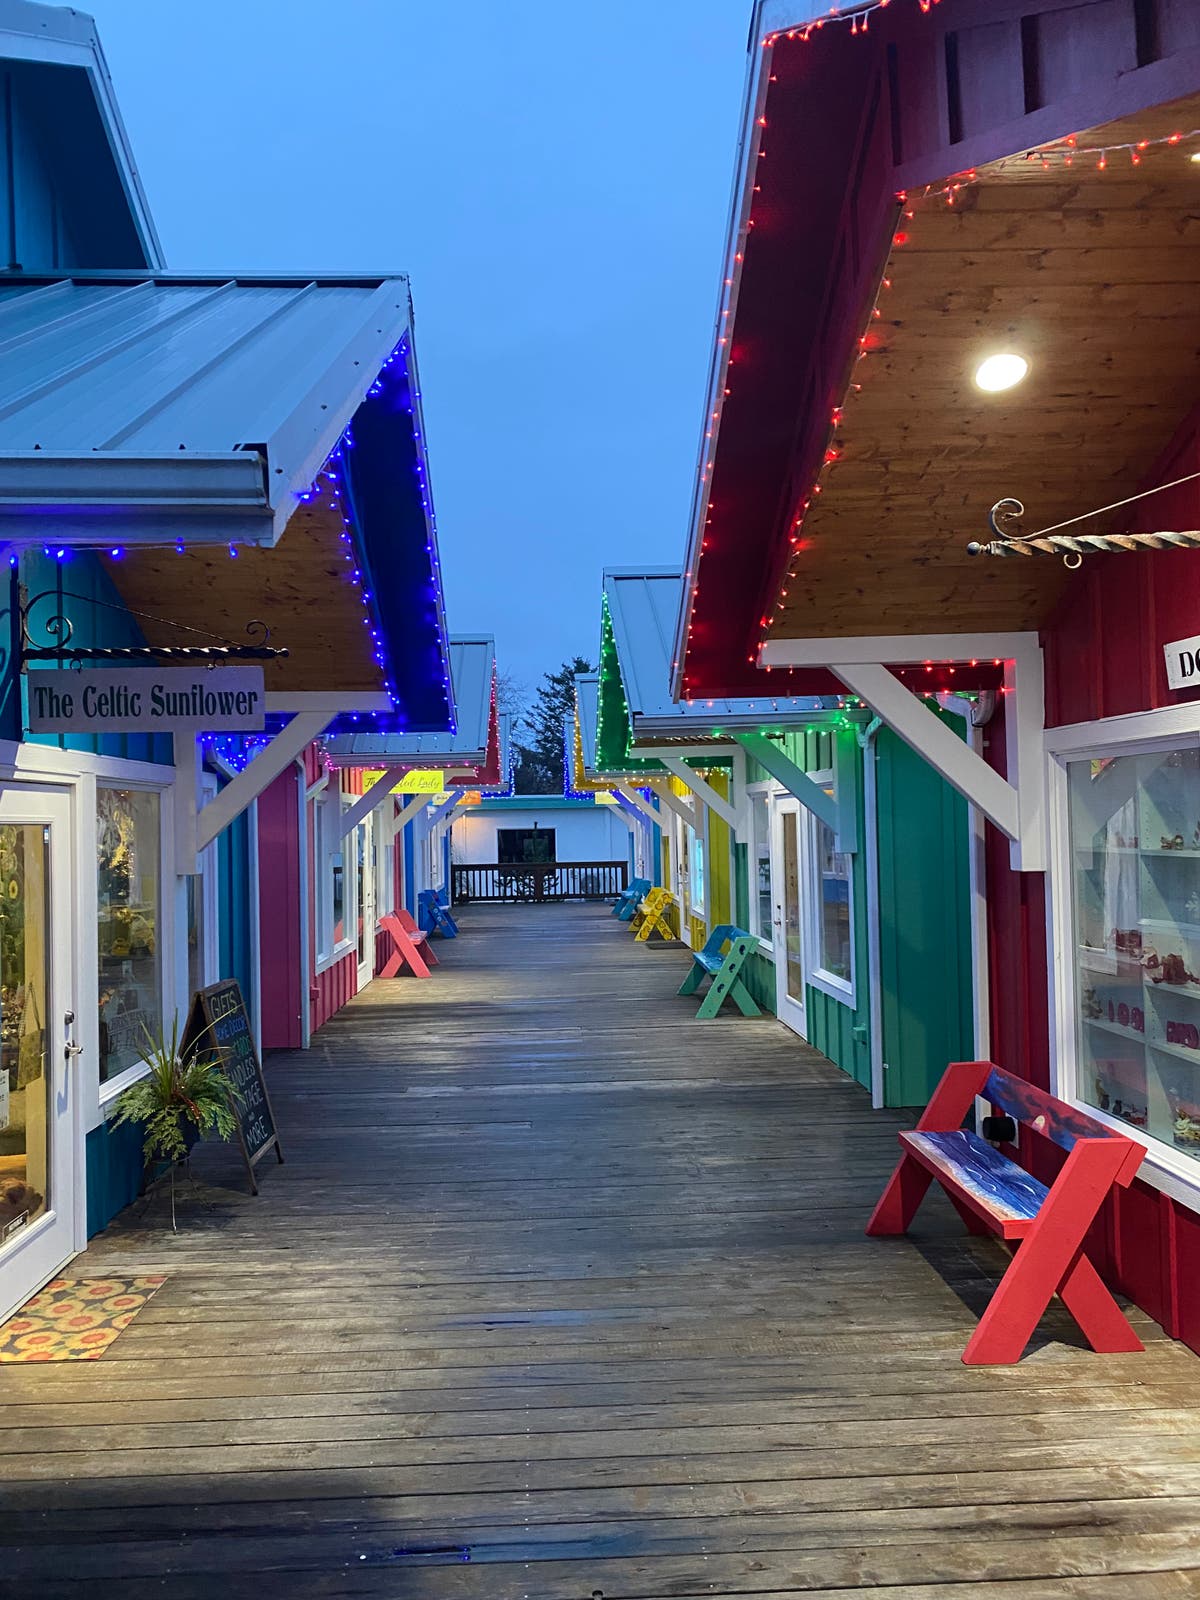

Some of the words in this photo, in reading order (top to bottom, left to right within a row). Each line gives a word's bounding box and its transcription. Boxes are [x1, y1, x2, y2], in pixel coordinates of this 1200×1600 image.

[34, 686, 73, 719] The
[82, 685, 142, 718] Celtic
[151, 684, 258, 717] Sunflower
[210, 990, 238, 1020] GIFTS
[227, 1056, 256, 1087] NDLES
[235, 1080, 264, 1119] VTAGE
[246, 1115, 268, 1151] MORE
